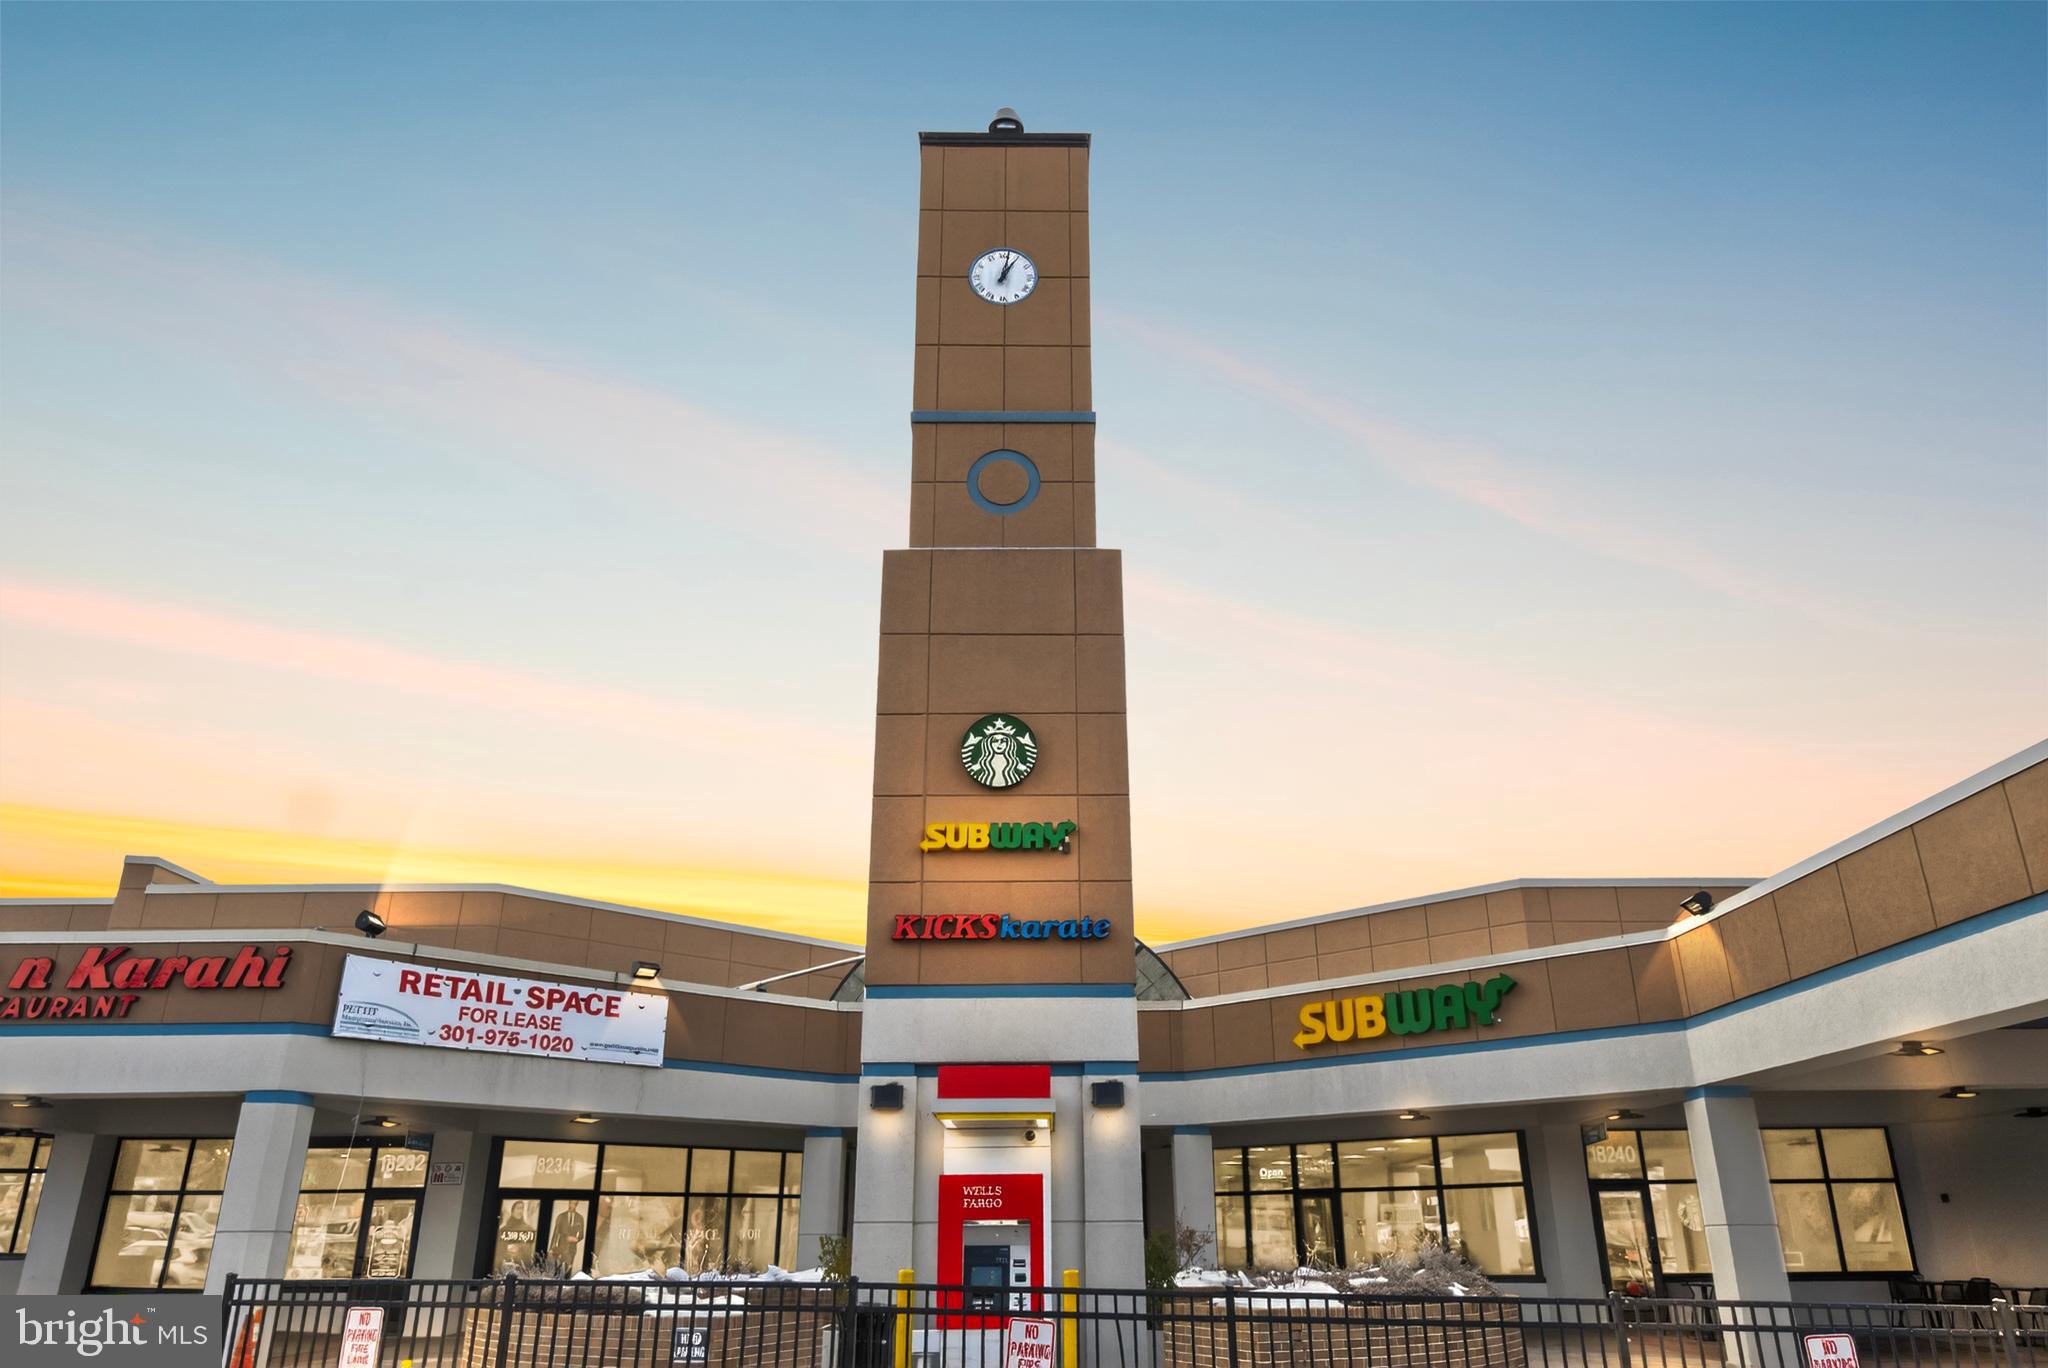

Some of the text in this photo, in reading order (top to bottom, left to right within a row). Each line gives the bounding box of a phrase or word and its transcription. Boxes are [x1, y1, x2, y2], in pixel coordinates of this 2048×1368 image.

[920, 820, 1077, 853] SUBWAY
[892, 913, 1111, 940] KICKS karate
[65, 945, 293, 990] Karahi
[399, 969, 622, 1019] RETAIL SPACE
[0, 996, 139, 1018] AURANT
[1292, 972, 1517, 1050] SUBWAY
[458, 1006, 562, 1032] FOR LEASE
[439, 1023, 574, 1054] 301-975-1020
[1591, 1145, 1635, 1163] 18240
[962, 1185, 1003, 1197] WELLS
[962, 1198, 1003, 1209] FARGO
[359, 1312, 371, 1326] NO
[1025, 1324, 1039, 1340] NO
[1010, 1341, 1051, 1360] PARKING
[1822, 1340, 1838, 1355] NO
